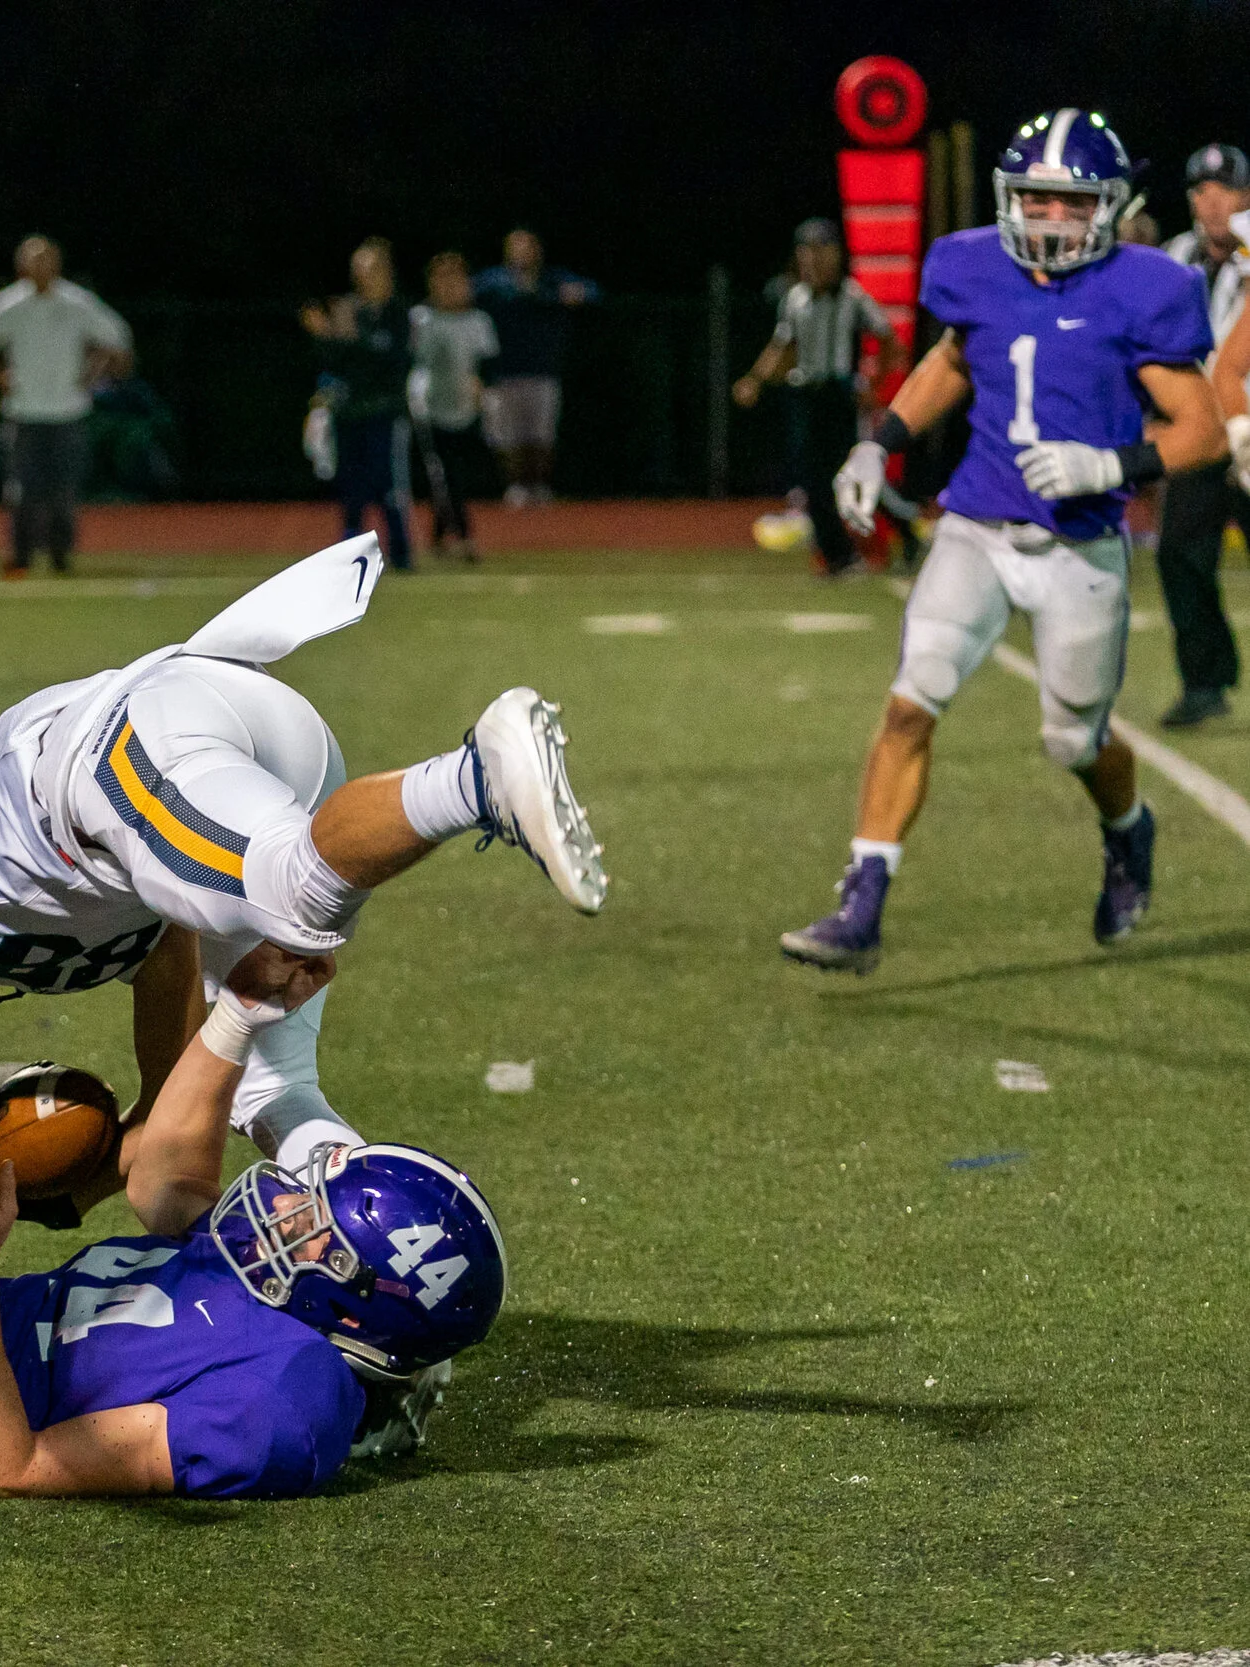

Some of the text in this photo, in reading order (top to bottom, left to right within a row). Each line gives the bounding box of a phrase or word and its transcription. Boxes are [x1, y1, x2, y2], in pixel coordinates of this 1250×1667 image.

[1007, 334, 1040, 446] 1
[35, 1246, 180, 1361] 44
[387, 1224, 470, 1311] 44
